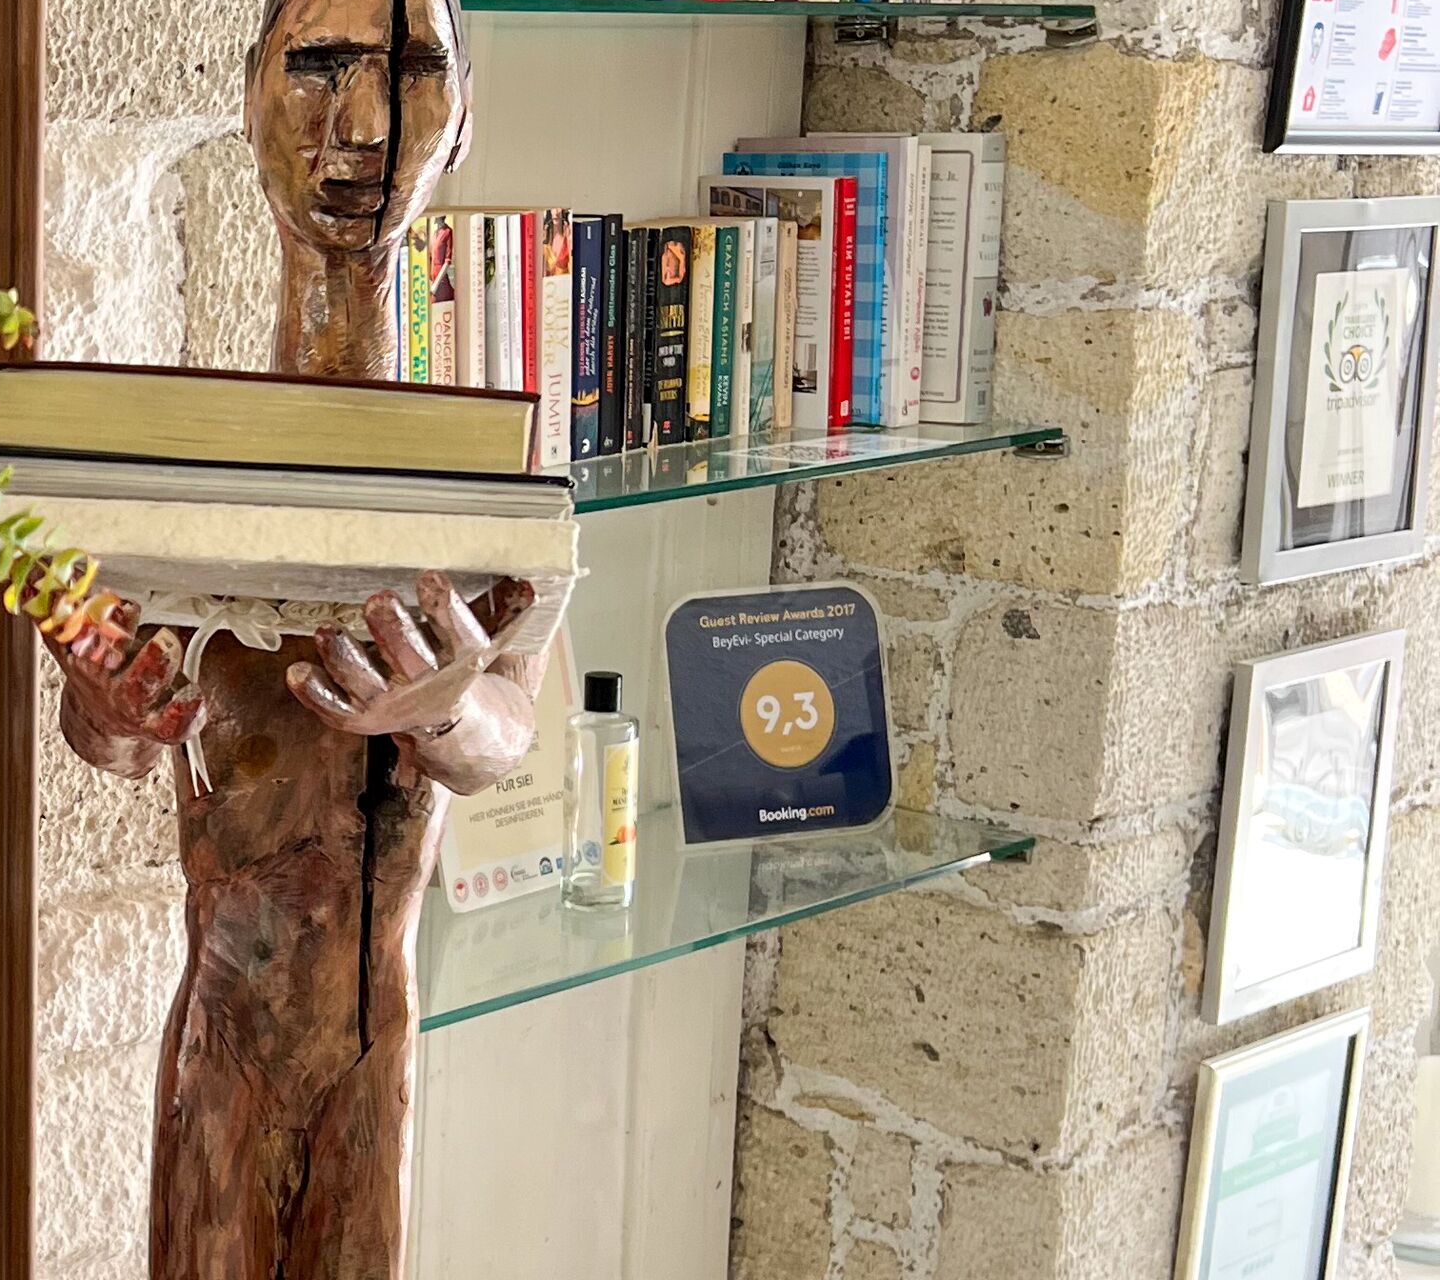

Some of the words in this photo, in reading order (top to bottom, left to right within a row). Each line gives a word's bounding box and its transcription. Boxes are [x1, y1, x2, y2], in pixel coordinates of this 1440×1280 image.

[609, 244, 617, 267] Glas
[724, 235, 733, 276] CRAZY
[412, 264, 420, 335] LLOYD
[419, 265, 427, 324] JOSIE
[475, 259, 483, 337] TEAHOUSE
[579, 266, 587, 303] KASHGAR
[608, 269, 617, 327] Splitterndes
[722, 280, 732, 312] RICH
[844, 265, 853, 307] TUTAR
[543, 280, 557, 366] COOPER
[555, 297, 569, 352] JILLY
[720, 315, 730, 366] ASIANS
[1342, 323, 1375, 341] CHOICE
[434, 320, 443, 385] CROSSIN
[441, 310, 453, 385] DANGERO
[606, 334, 614, 368] HARVEY
[606, 370, 614, 393] JOHN
[547, 372, 563, 438] JUMP!
[1326, 395, 1380, 417] tripadvisor
[1327, 470, 1365, 489] WINNER
[699, 613, 736, 629] Guest
[738, 611, 780, 626] Review
[782, 608, 825, 621] Awards
[826, 603, 856, 618] 2017
[754, 630, 793, 647] Special
[795, 627, 845, 645] Category
[755, 691, 819, 736] 9,3
[495, 776, 516, 795] FÜR
[516, 773, 534, 790] SIE!
[468, 810, 486, 824] HIER
[485, 803, 516, 819] KÖNNEN
[516, 799, 527, 812] SIE
[759, 804, 835, 824] Booking.com
